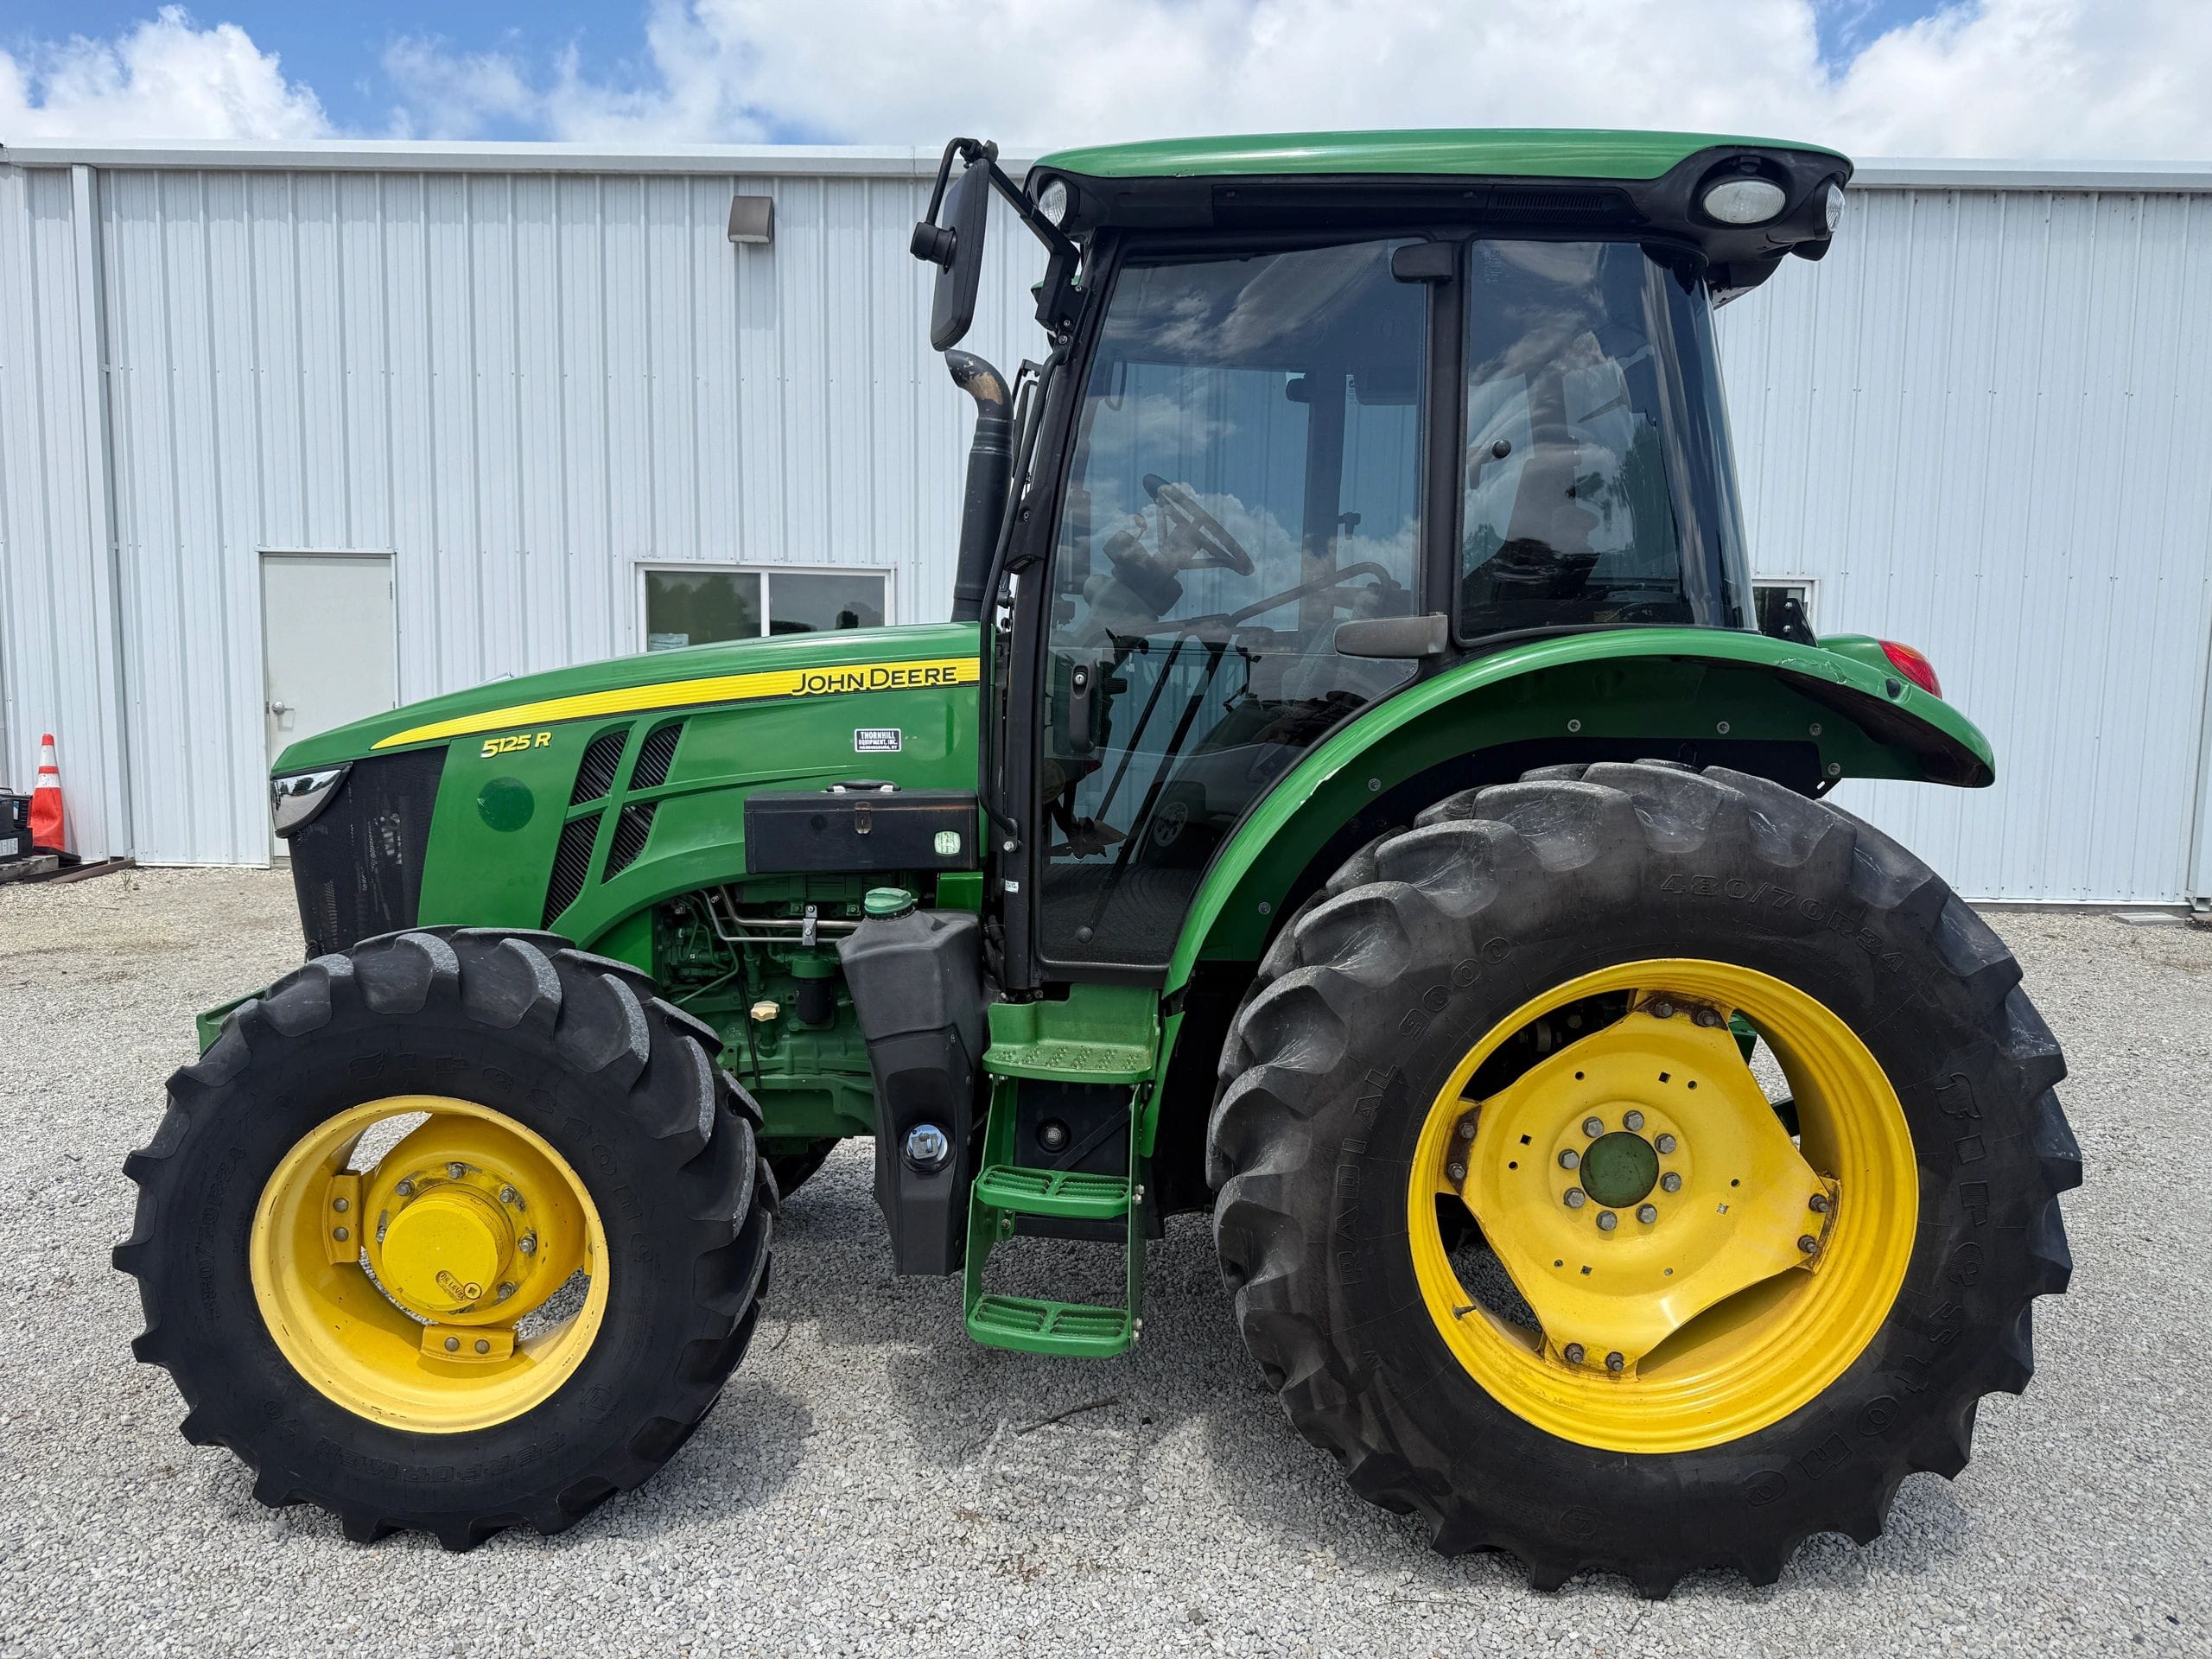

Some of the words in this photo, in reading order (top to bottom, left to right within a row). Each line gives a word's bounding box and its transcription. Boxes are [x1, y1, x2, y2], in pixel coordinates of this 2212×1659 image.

[791, 673, 864, 692] JOHN
[870, 666, 957, 687] DEERE
[480, 734, 532, 758] 5125
[535, 732, 551, 747] R
[1660, 873, 1907, 974] 480/70R34
[1334, 1064, 1398, 1287] RADIAL
[1398, 935, 1511, 1041] 9000
